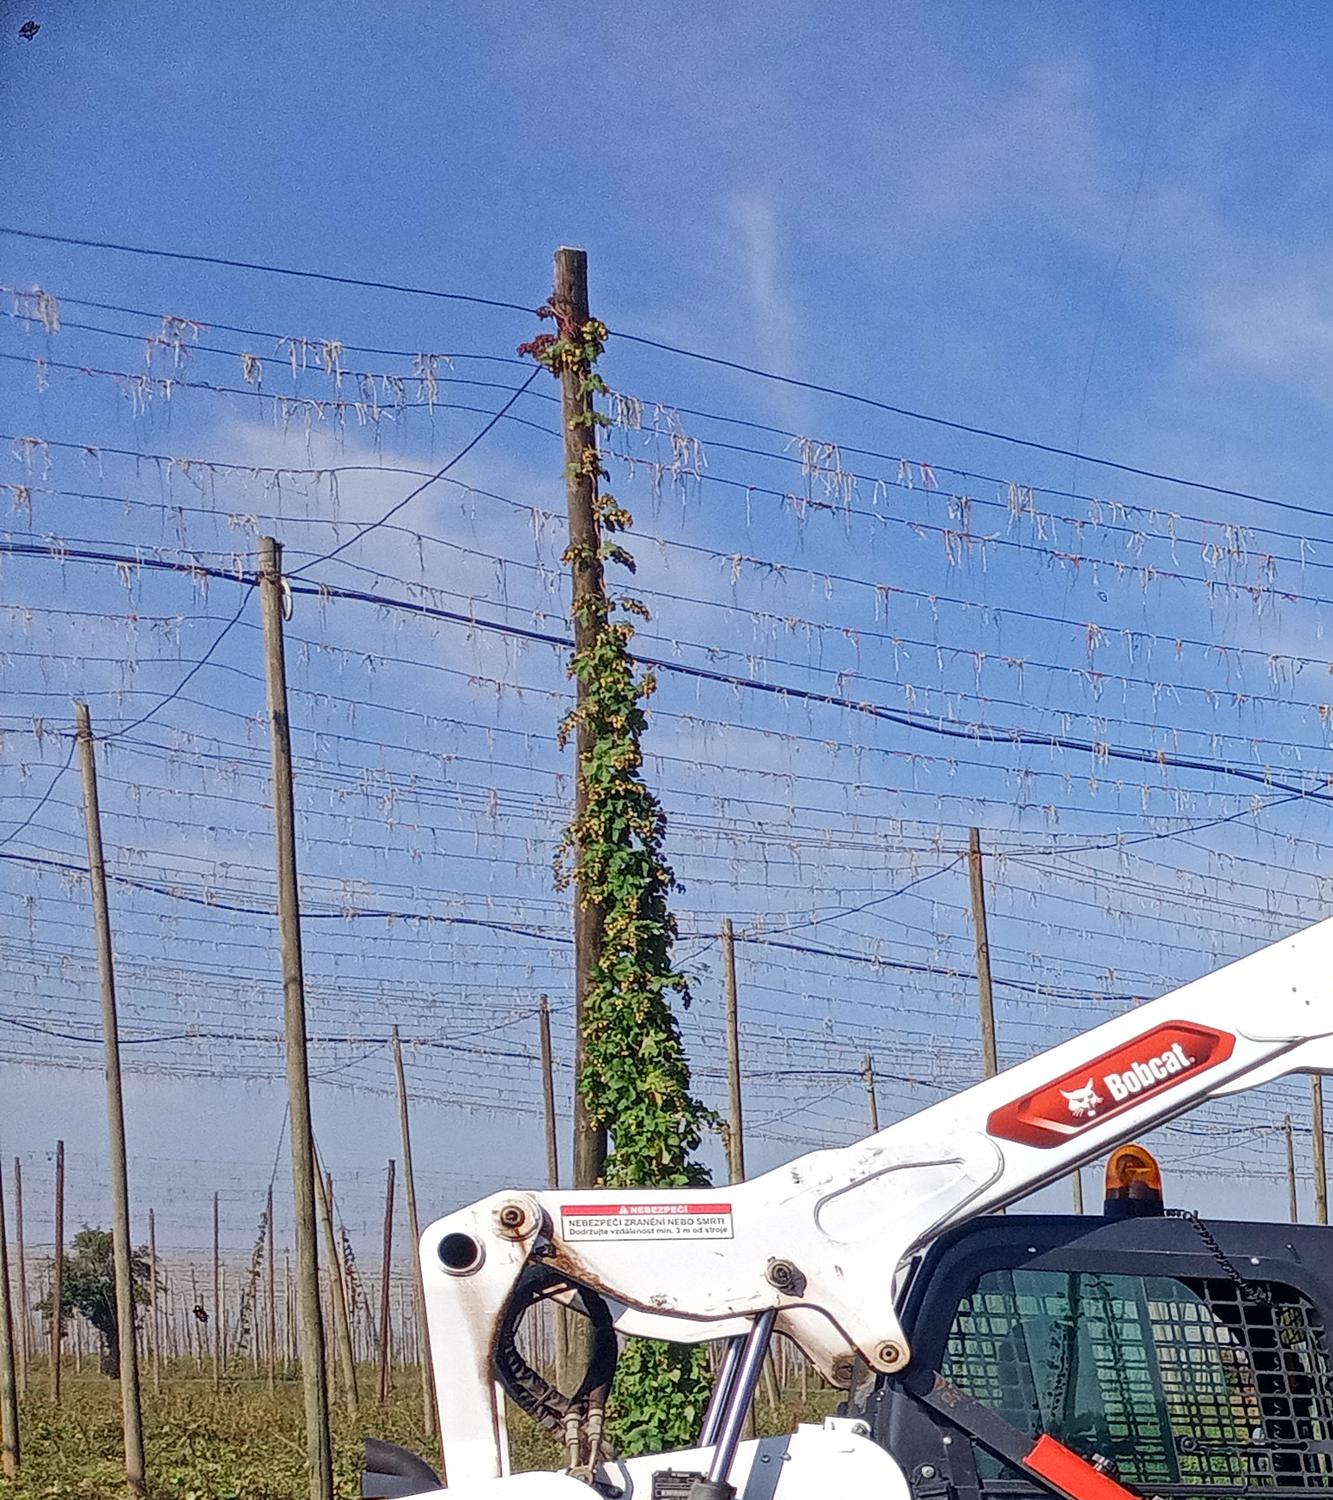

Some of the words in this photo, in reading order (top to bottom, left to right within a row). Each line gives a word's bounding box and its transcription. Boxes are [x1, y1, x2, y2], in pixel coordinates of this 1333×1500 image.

[1103, 1042, 1191, 1102] Bobcat
[667, 1218, 694, 1226] NEBO
[696, 1217, 725, 1225] SMRTI
